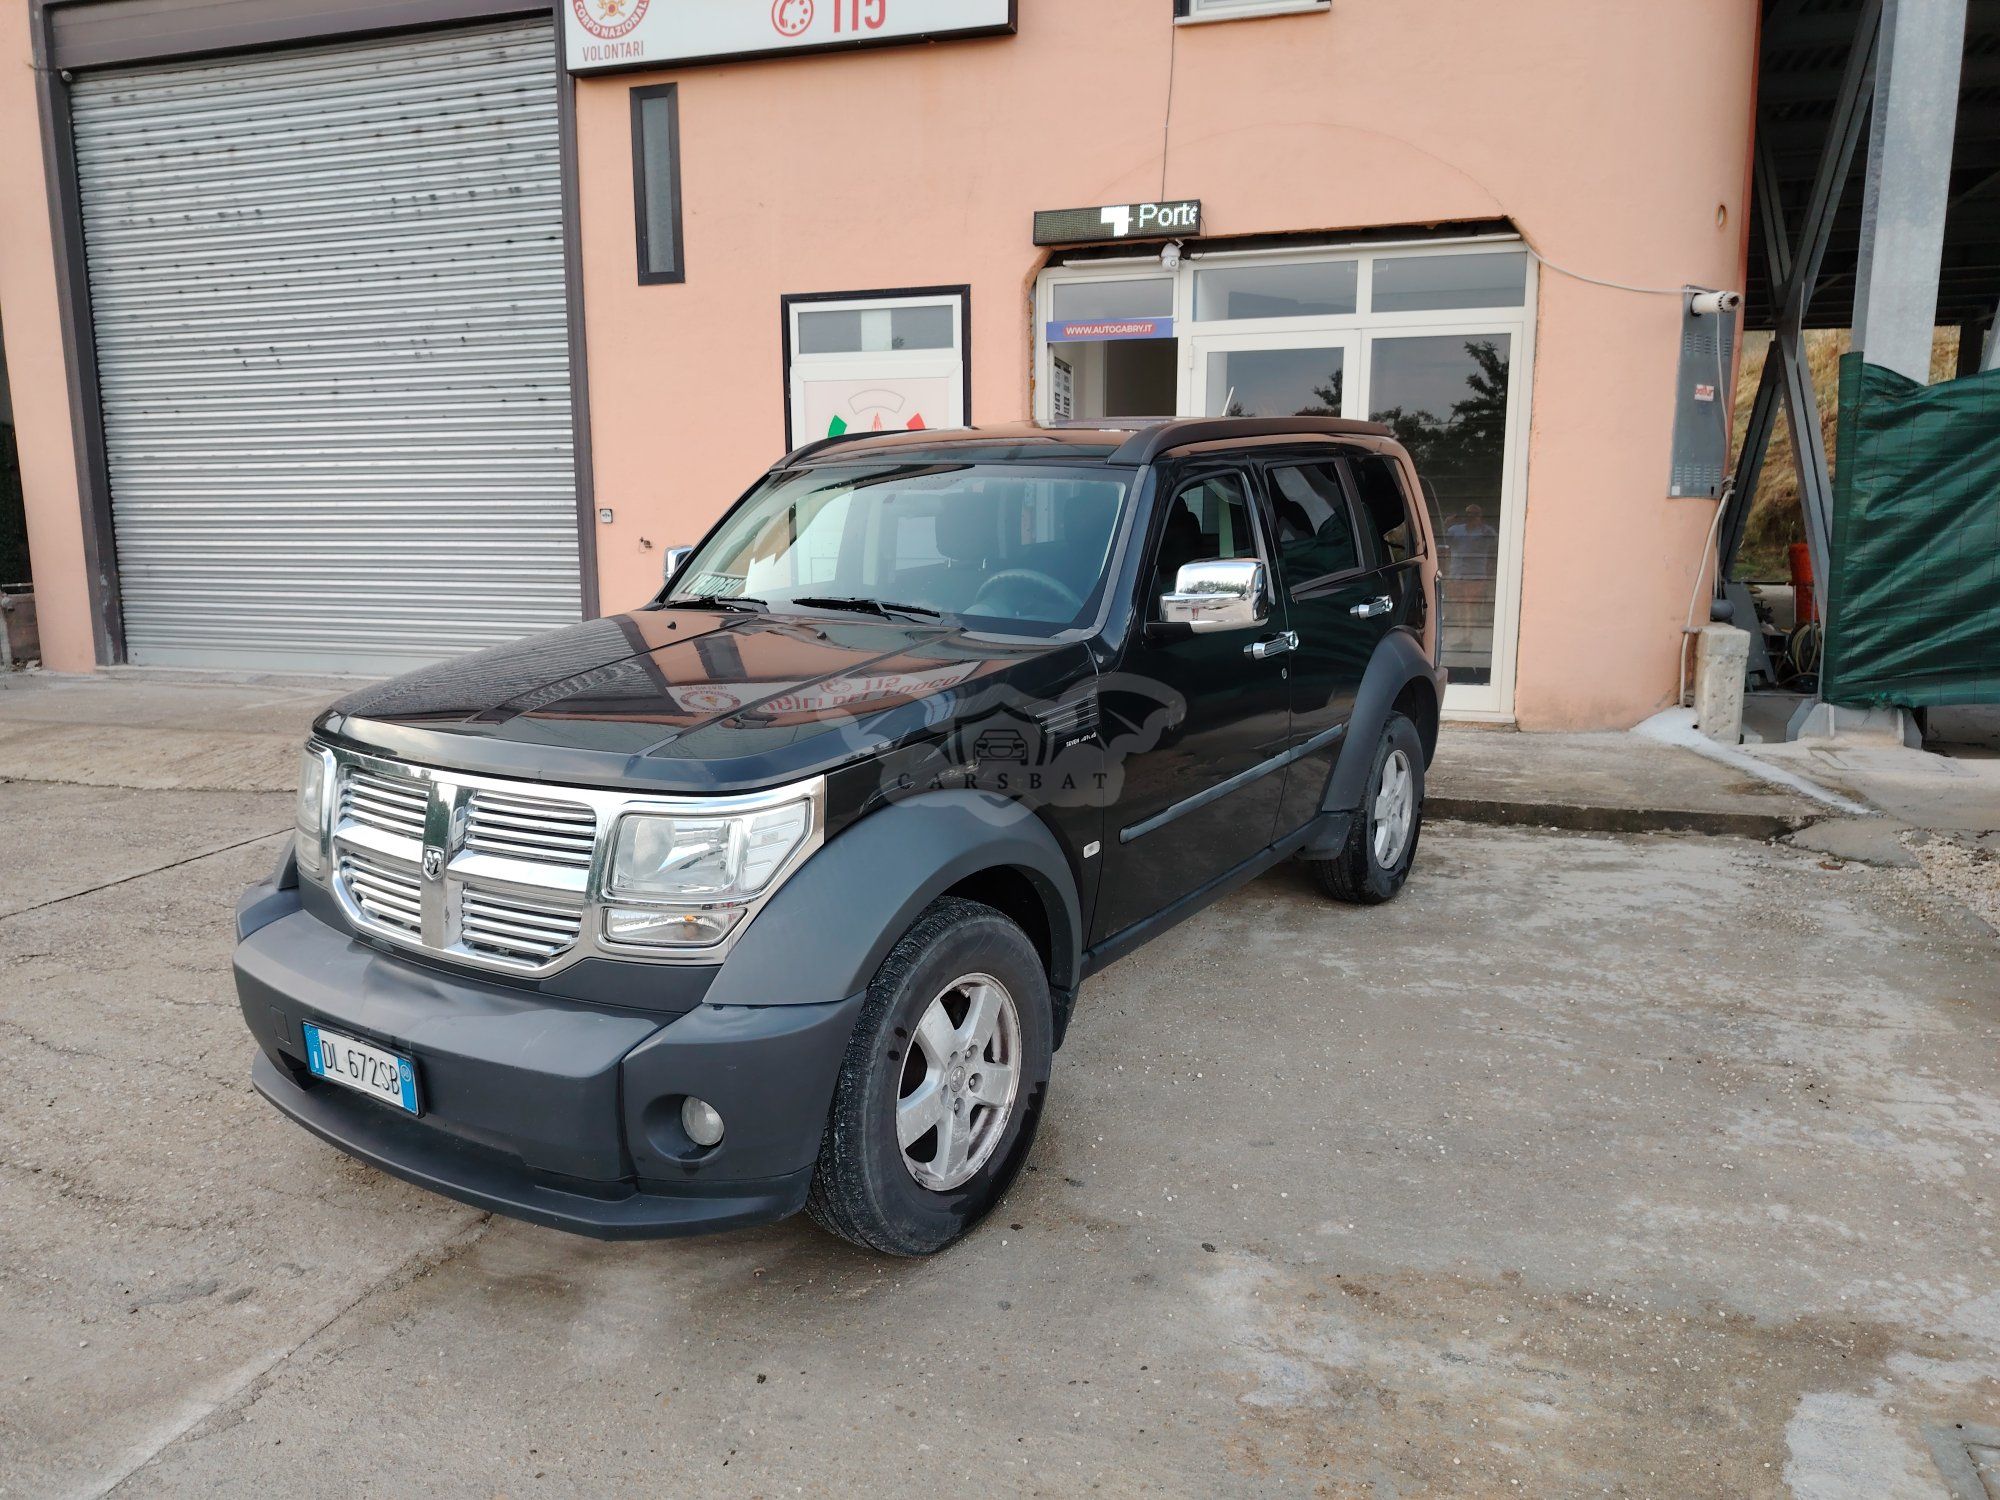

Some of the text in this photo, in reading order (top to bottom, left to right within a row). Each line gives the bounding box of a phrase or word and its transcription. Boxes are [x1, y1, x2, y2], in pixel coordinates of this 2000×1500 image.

[574, 0, 649, 38] CORPO NAZIONAL
[582, 40, 644, 62] VOLONTARI
[1066, 323, 1153, 335] WWW.AUTOGABRY.IT
[321, 1040, 344, 1074] DL
[347, 1049, 400, 1095] 672SB
